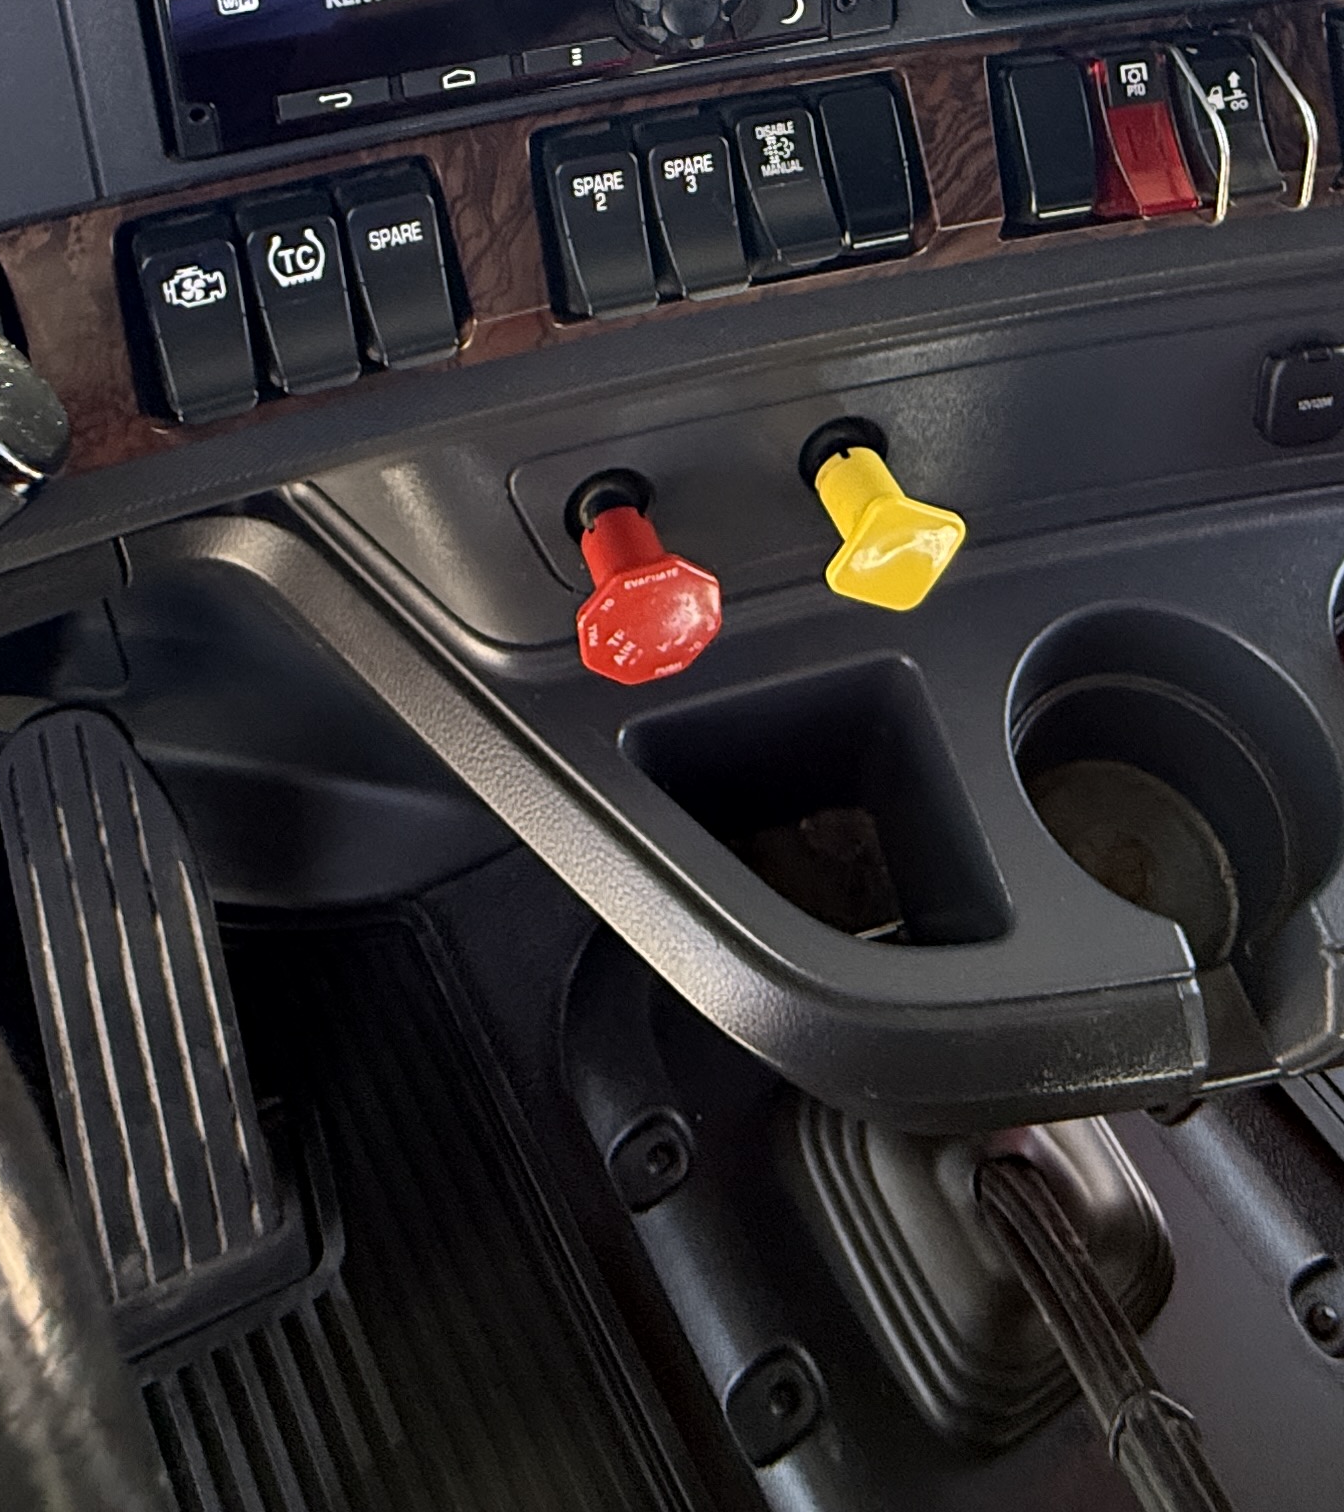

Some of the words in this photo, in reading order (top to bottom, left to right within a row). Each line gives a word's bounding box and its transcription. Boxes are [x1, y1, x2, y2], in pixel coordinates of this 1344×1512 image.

[1126, 82, 1147, 98] PTO
[754, 120, 795, 140] DISABLE
[663, 153, 714, 180] SPARE
[760, 158, 804, 178] MANUAL
[572, 170, 625, 198] SPARE
[685, 175, 698, 194] 3
[594, 192, 608, 212] 2
[368, 220, 424, 251] SPARE
[277, 244, 316, 274] TC
